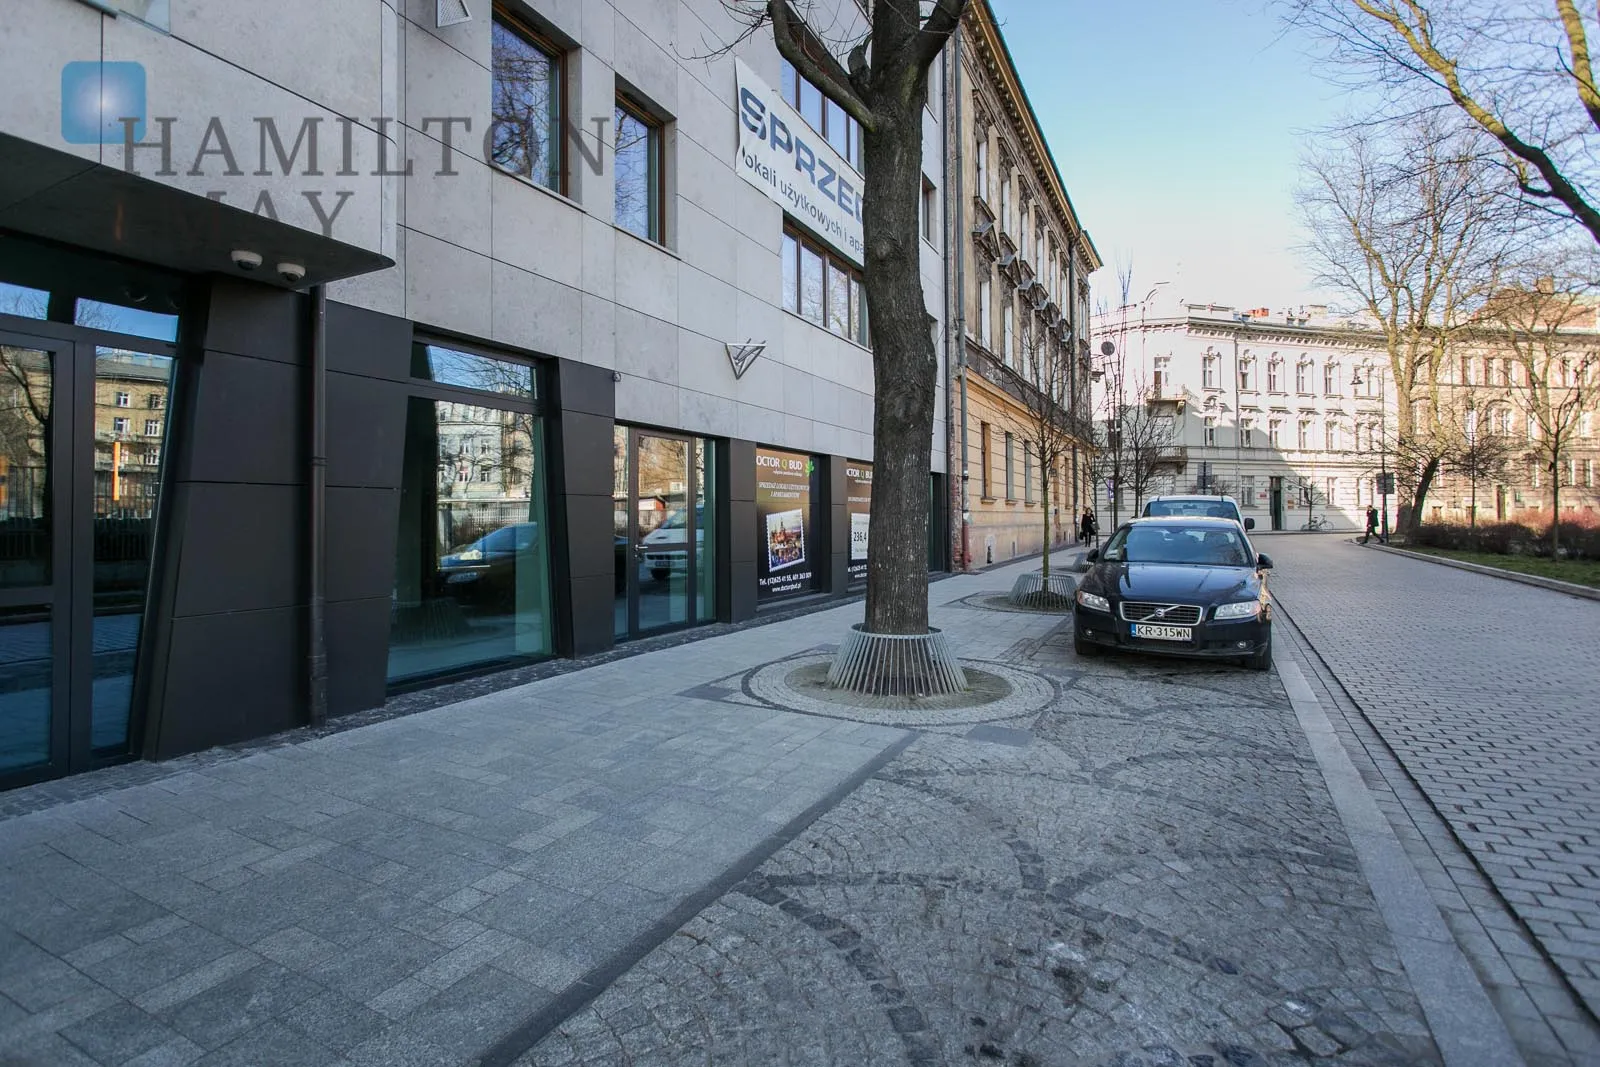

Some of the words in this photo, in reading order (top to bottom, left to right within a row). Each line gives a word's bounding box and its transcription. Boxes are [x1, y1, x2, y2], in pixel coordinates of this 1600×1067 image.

[780, 180, 842, 237] użytkowych
[788, 459, 802, 470] BUD
[1137, 625, 1153, 636] KR
[1156, 627, 1190, 638] 315WN
